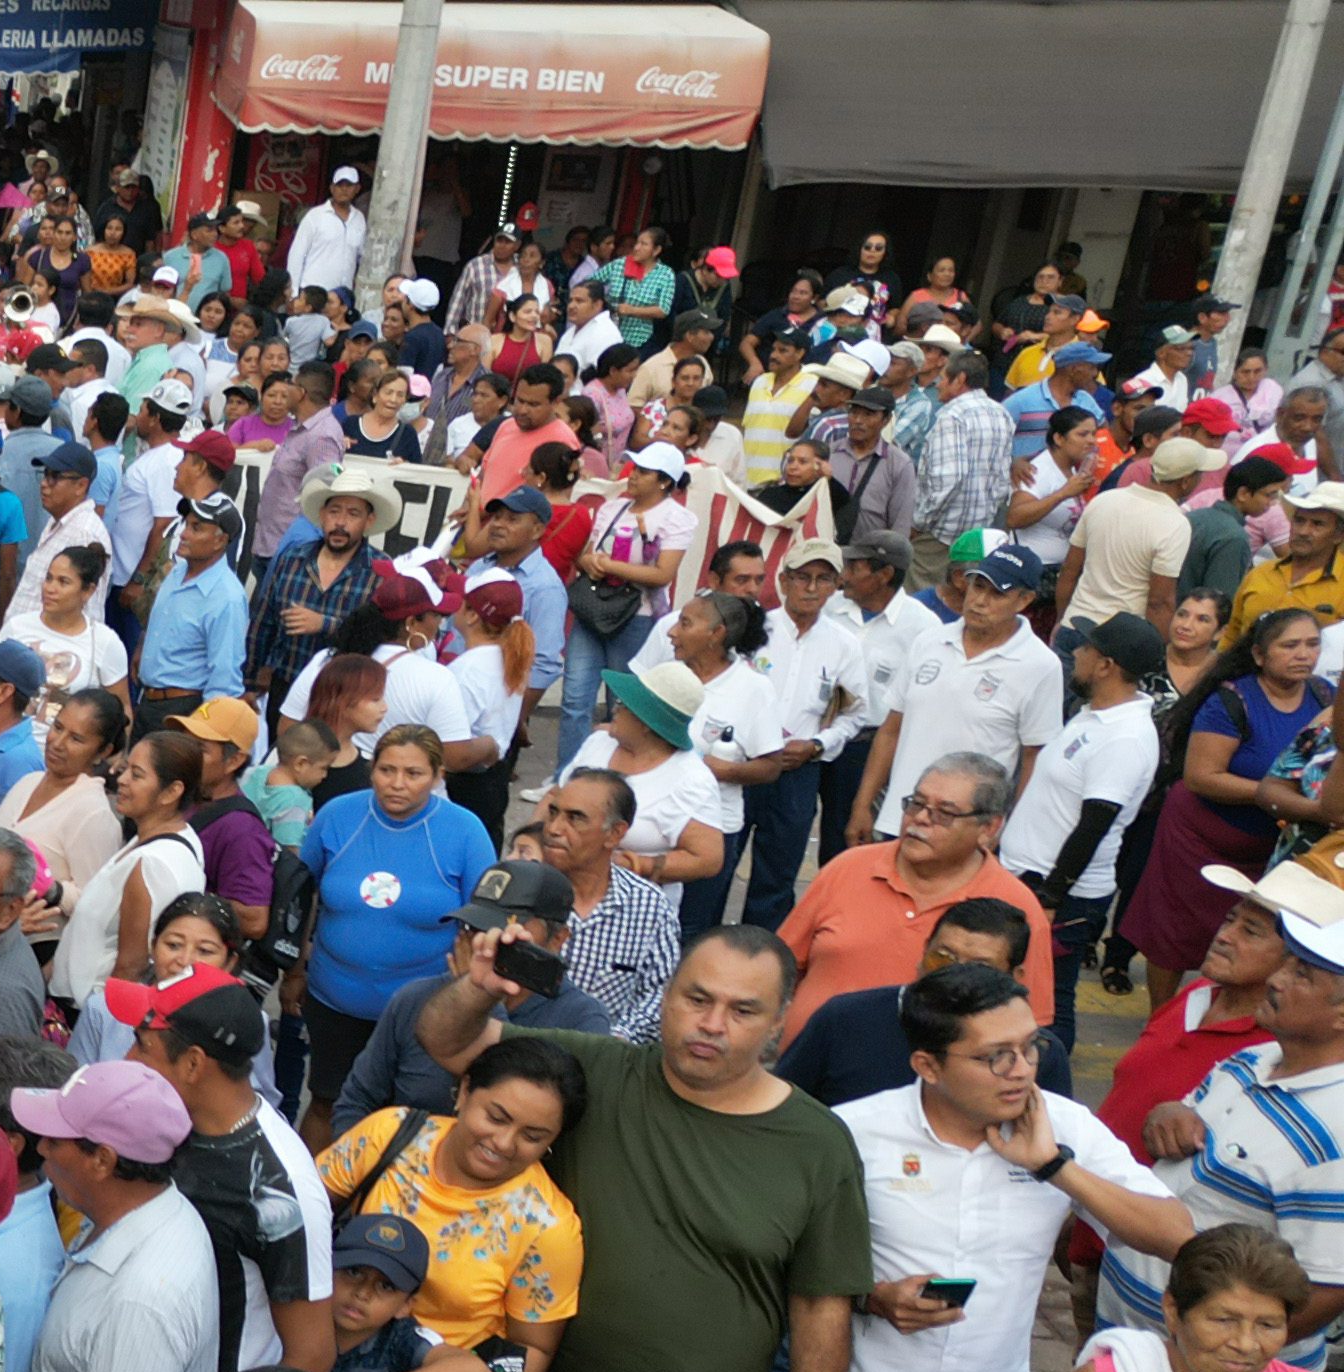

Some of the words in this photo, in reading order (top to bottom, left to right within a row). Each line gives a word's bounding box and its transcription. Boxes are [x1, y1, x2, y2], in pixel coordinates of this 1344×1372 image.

[40, 27, 144, 50] LLAMADAS
[434, 64, 529, 91] SUPER
[535, 68, 606, 94] BIEN
